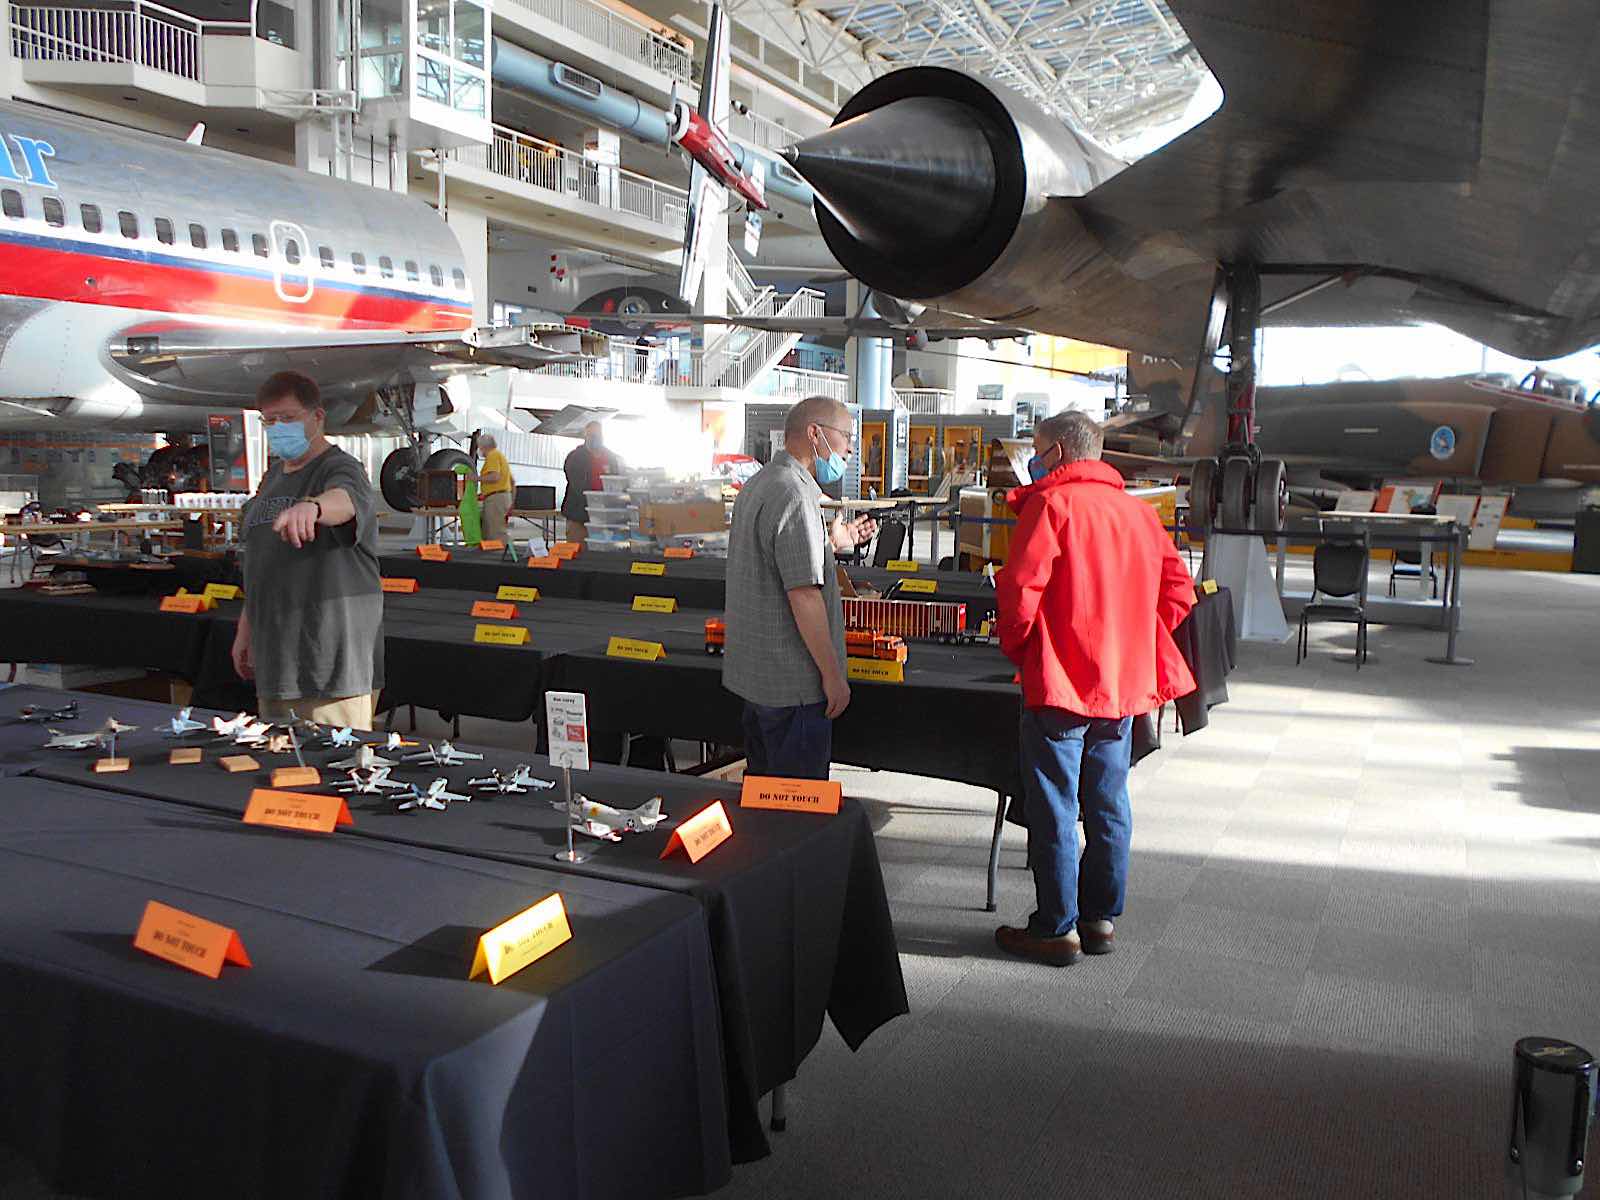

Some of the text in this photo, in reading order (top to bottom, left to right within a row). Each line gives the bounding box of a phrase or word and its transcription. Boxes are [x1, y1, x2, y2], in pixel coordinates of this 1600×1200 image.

[759, 792, 819, 804] DO NOT TOUCH
